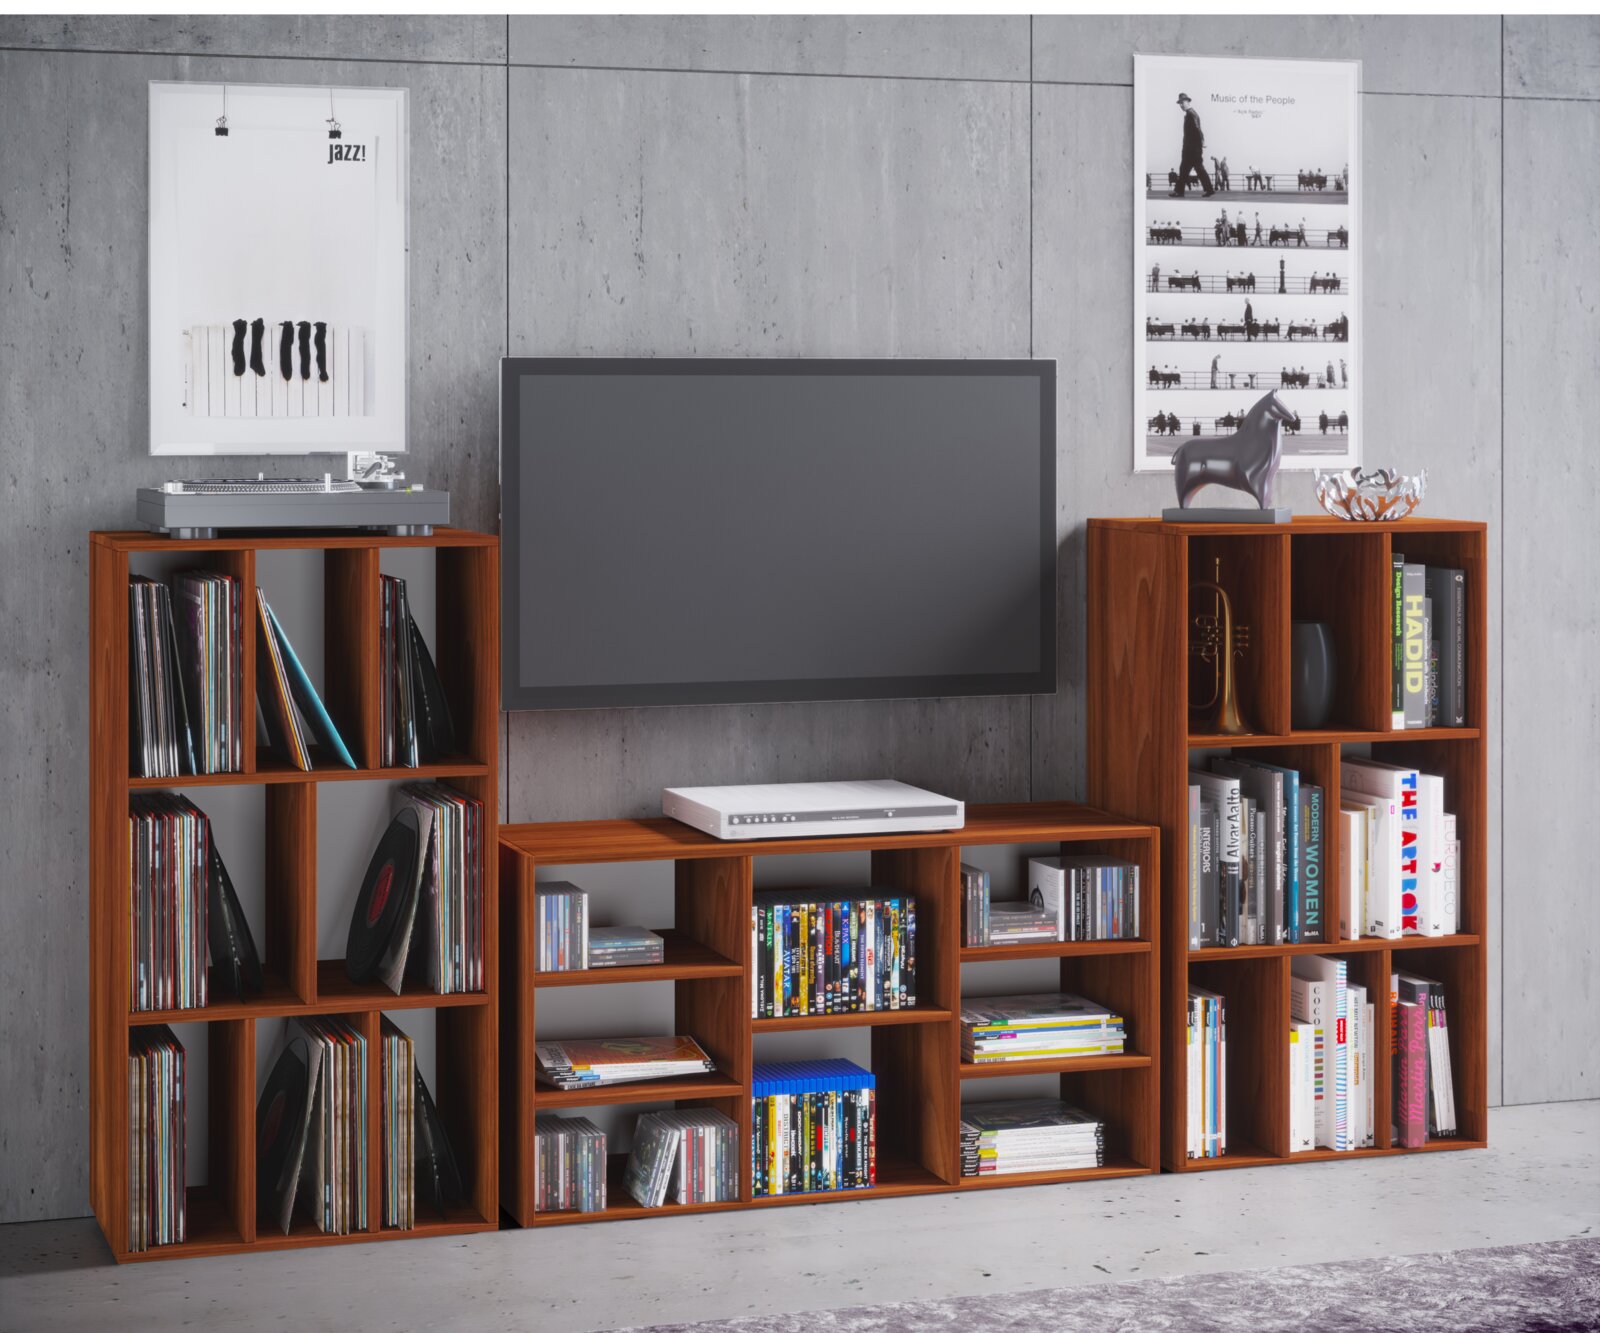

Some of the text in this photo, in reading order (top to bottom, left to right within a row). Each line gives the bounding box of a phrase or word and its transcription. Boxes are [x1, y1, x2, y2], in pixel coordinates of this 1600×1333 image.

[1210, 93, 1296, 106] Music of the People
[327, 144, 366, 164] jazz!
[1406, 595, 1423, 694] HADID
[1402, 773, 1417, 821] THE
[1227, 788, 1240, 858] Alvar Aalto
[1402, 831, 1417, 874] ART
[1306, 844, 1319, 925] WOMEN
[1408, 1008, 1425, 1053] Parr
[1408, 1057, 1425, 1121] Martin
